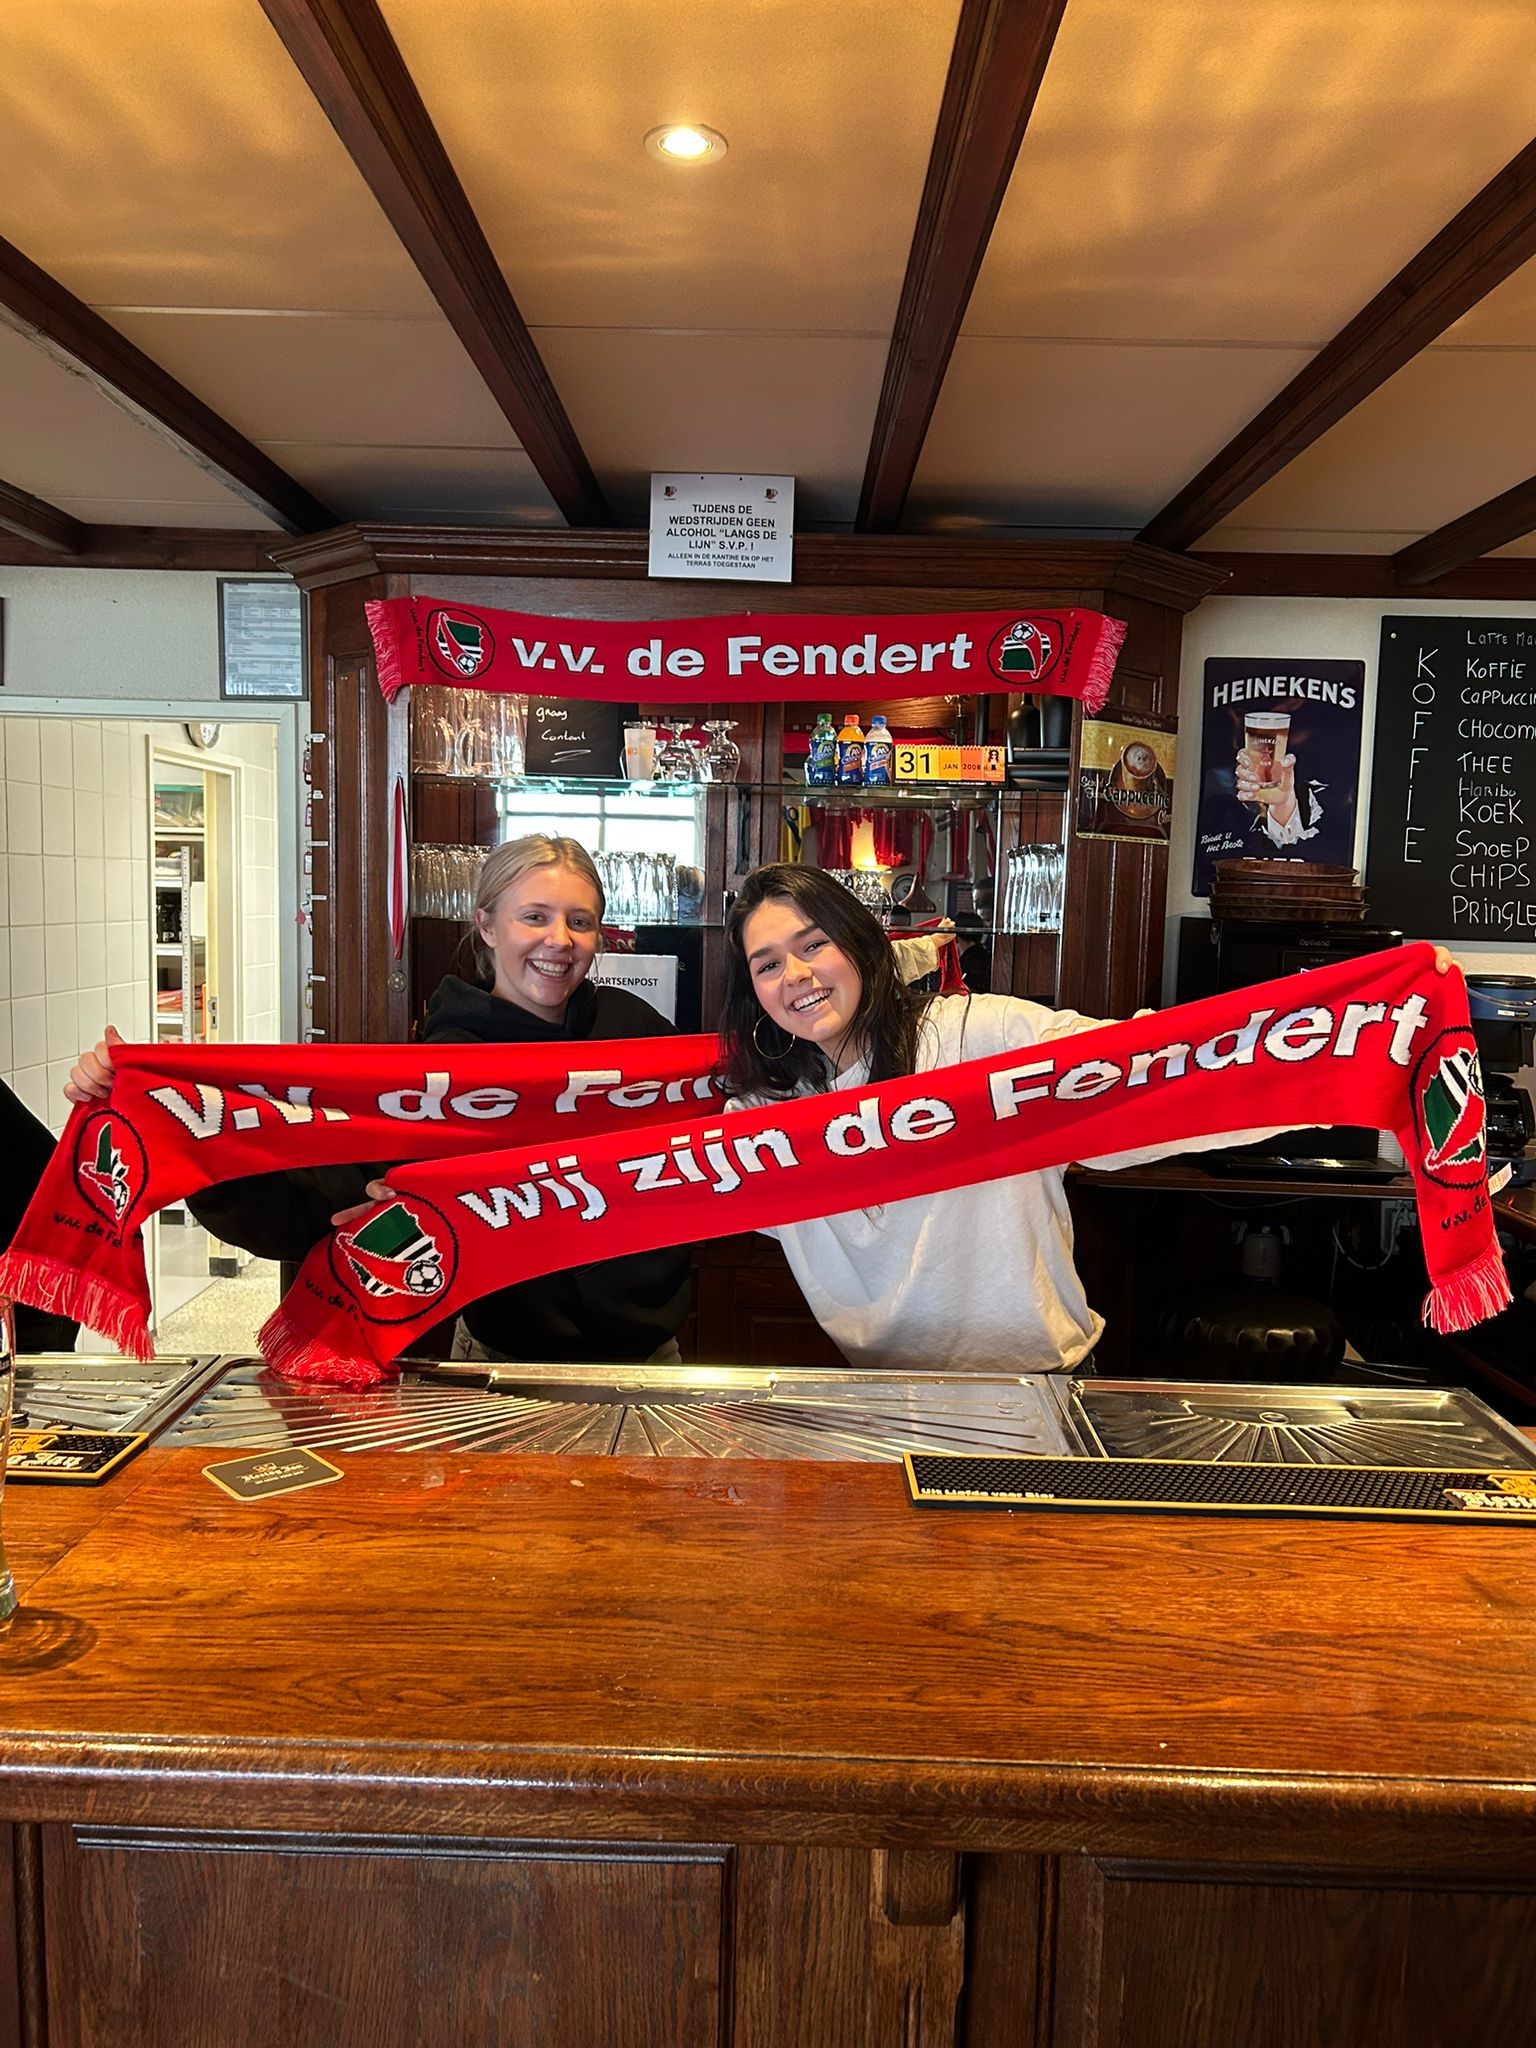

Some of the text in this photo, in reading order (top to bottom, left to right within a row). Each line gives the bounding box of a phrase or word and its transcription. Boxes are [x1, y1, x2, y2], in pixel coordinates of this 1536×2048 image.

[692, 504, 753, 514] TIJDENS DE
[669, 516, 775, 527] WEDSTRIJDEN GEEN
[666, 528, 716, 537] ALCOHOL
[763, 531, 777, 540] DE
[719, 541, 748, 551] S.V.P.
[511, 633, 973, 677] v.v. de Fendert
[1213, 676, 1357, 709] HEINEKEN'S
[1456, 751, 1513, 774] THEE
[1459, 797, 1524, 824] KOEK
[377, 1071, 521, 1120] de
[554, 1069, 732, 1114] Fen
[455, 992, 1430, 1231] wij zijn de Fendert
[85, 1221, 104, 1236] de
